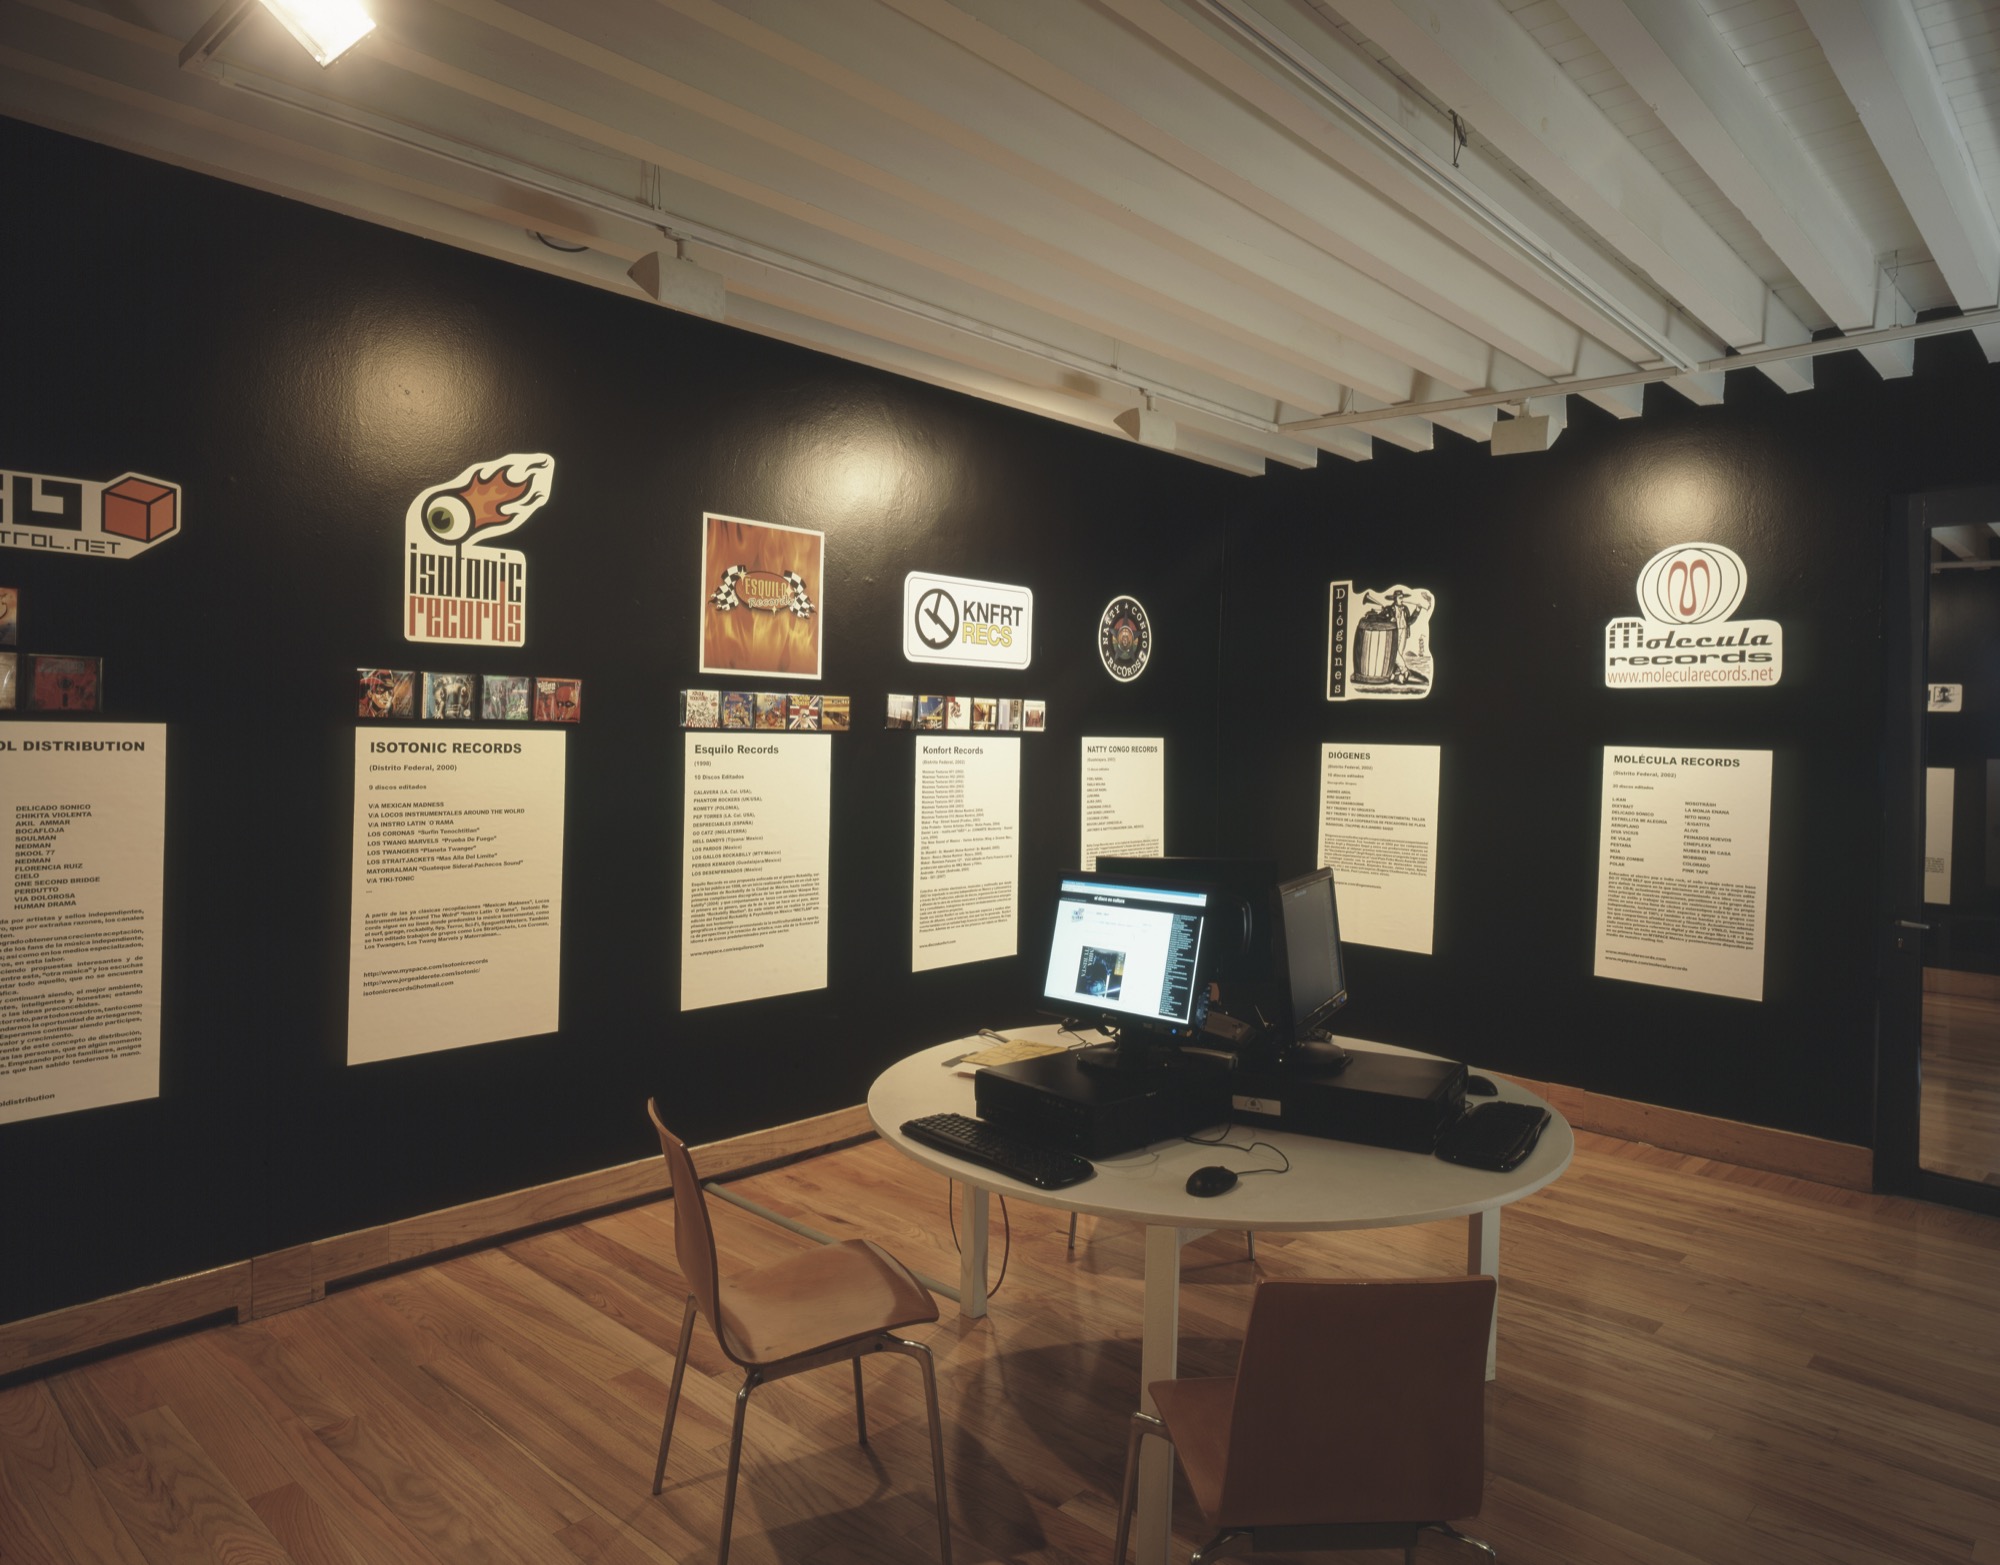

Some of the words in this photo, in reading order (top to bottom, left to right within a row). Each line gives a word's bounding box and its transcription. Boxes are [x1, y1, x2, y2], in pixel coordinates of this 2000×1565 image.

[410, 543, 522, 603] isotonic
[745, 577, 788, 598] ESQUILO
[748, 595, 795, 608] Records
[409, 586, 521, 642] records
[963, 600, 1023, 626] KNFRT
[1103, 605, 1120, 645] NATTY
[1131, 606, 1147, 649] CONGO
[962, 621, 1012, 648] RECS
[1334, 587, 1347, 695] Diógenes
[1609, 649, 1773, 666] records
[1107, 656, 1141, 677] RECORDS
[1608, 666, 1774, 684] www.molecularecords.net
[23, 741, 145, 751] DISTRIBUTION
[371, 742, 447, 753] ISOTONIC
[452, 743, 522, 753] RECORDS
[695, 744, 734, 755] Esquilo
[737, 745, 779, 754] Records
[923, 746, 951, 754] Konfort
[953, 746, 983, 754] Records
[1328, 752, 1371, 760] DIÓGENES
[1614, 755, 1677, 765] MOLÉCULA
[1681, 757, 1740, 767] RECORDS
[382, 856, 435, 864] STRAITJACKETS
[367, 866, 418, 874] MATORRALMAN
[31, 893, 75, 901] DOLOROSA
[88, 909, 144, 917] independientes,
[12, 1065, 27, 1074] que
[72, 1056, 109, 1064] tendernos
